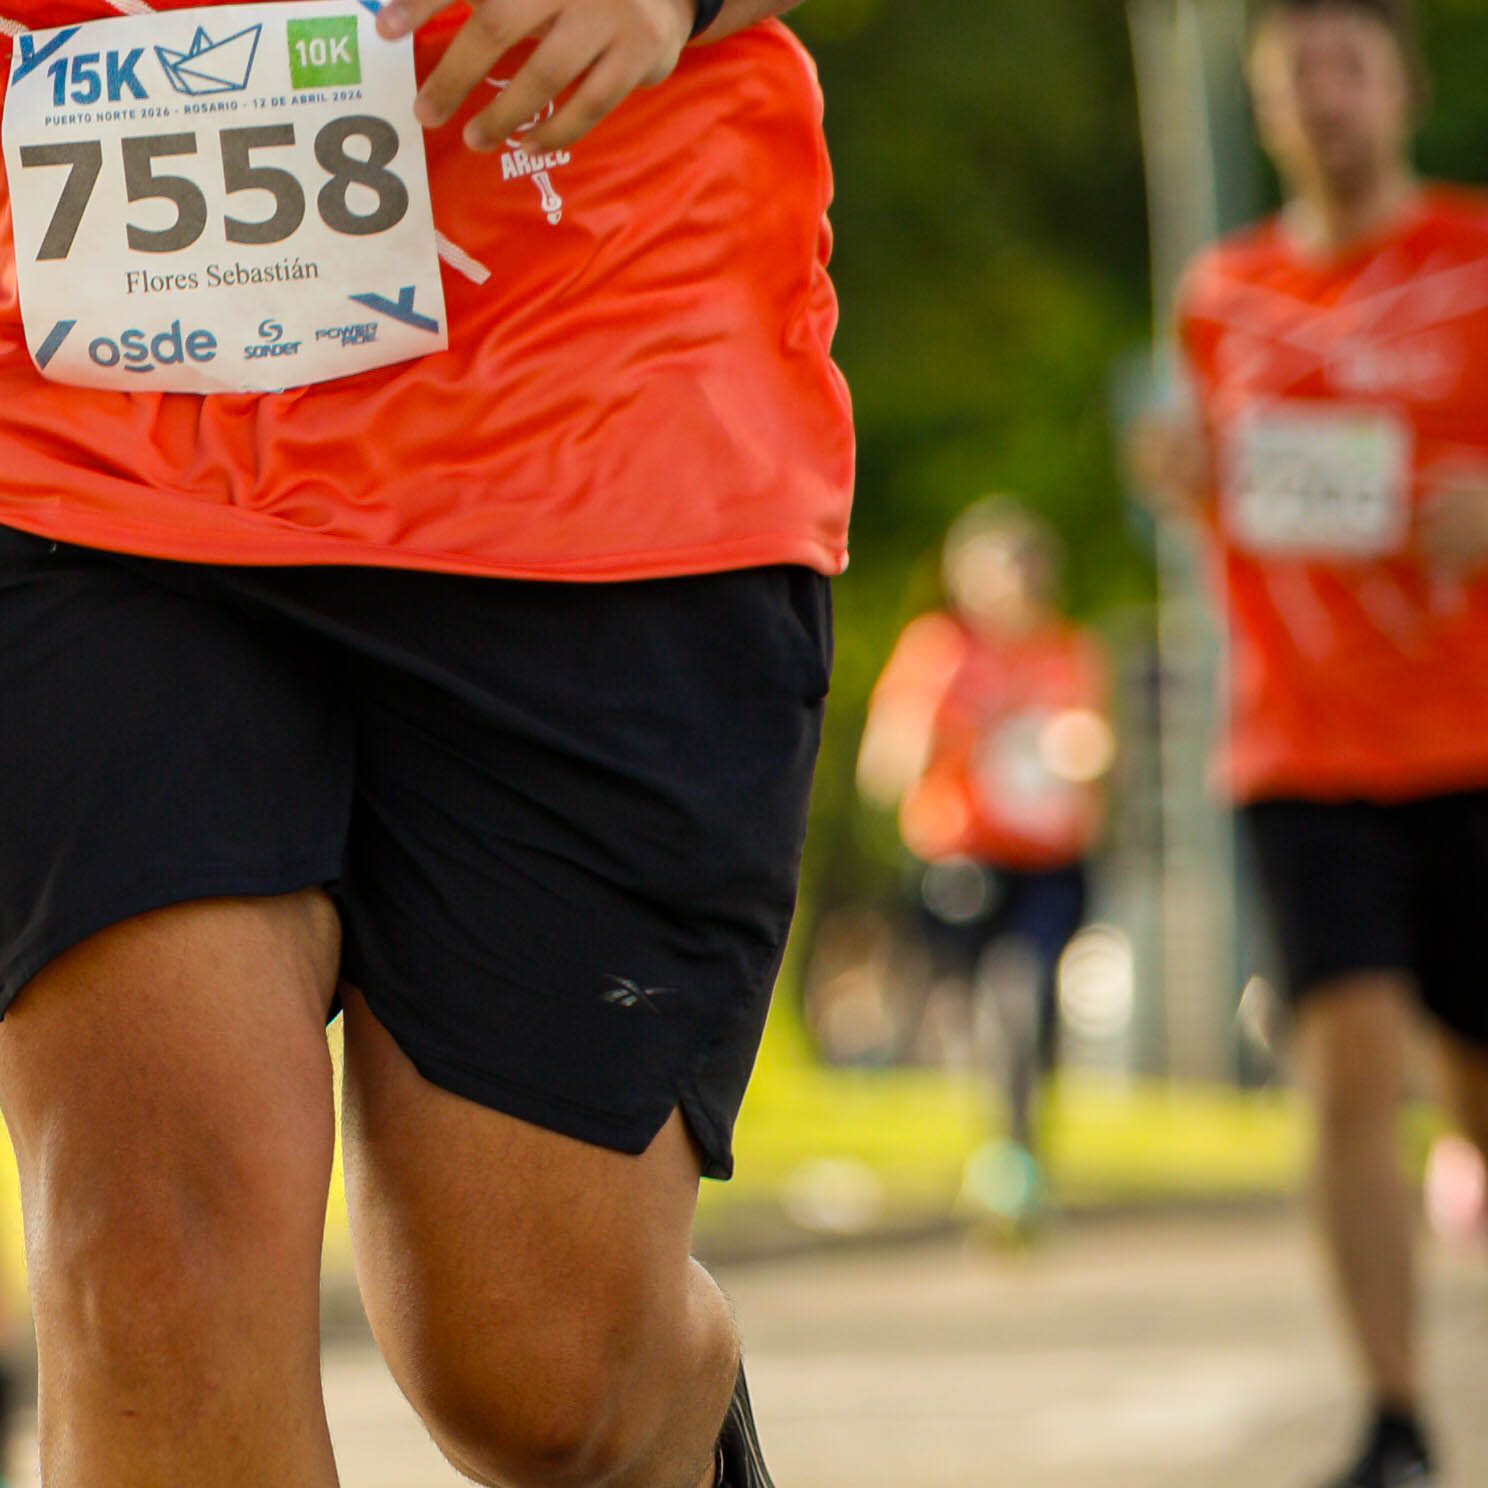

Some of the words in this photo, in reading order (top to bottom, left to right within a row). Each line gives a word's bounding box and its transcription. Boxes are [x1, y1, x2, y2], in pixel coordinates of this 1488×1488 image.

[295, 37, 352, 68] 10K
[46, 47, 150, 107] 15K
[44, 113, 92, 127] PUERTO
[96, 109, 136, 122] NORTE
[184, 99, 238, 115] ROSARIO
[272, 95, 289, 107] DE
[291, 91, 328, 105] ABRIL
[19, 113, 410, 262] 7558
[126, 272, 199, 295] Flores
[206, 259, 320, 288] Sebastián
[88, 319, 218, 372] osde
